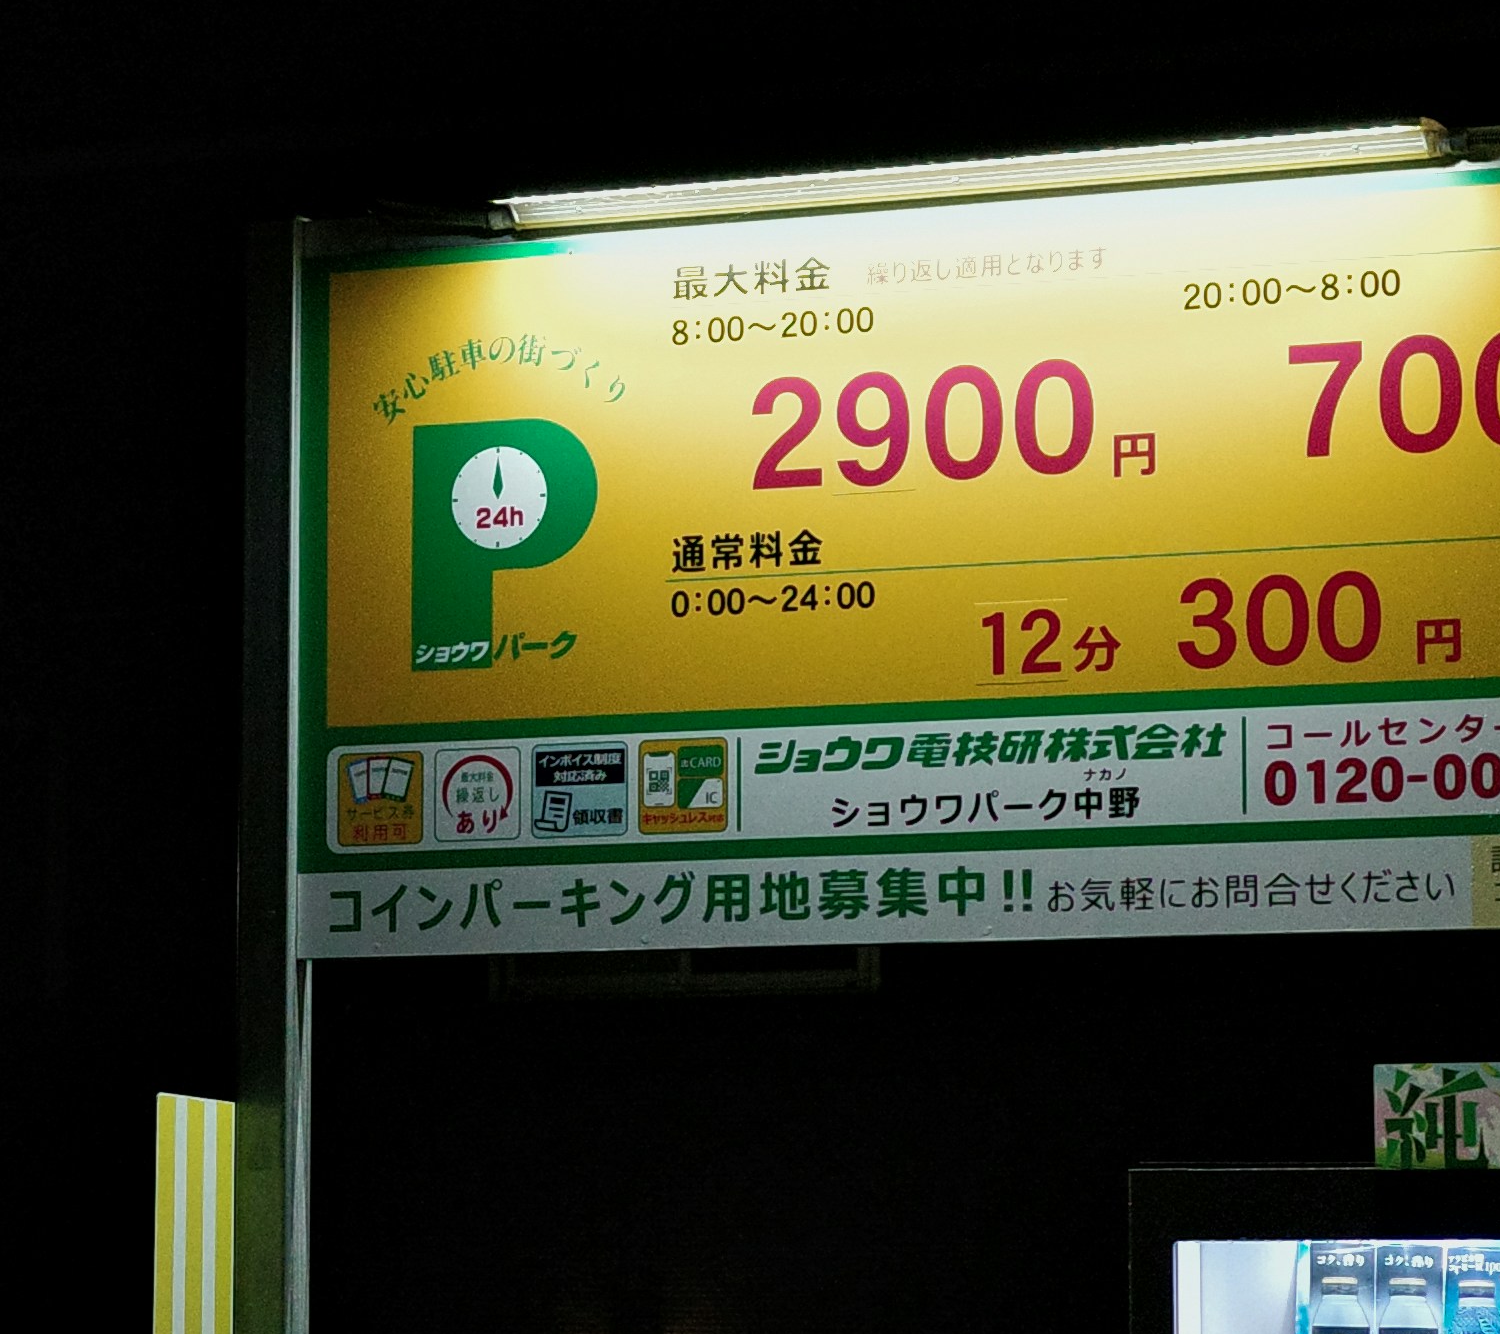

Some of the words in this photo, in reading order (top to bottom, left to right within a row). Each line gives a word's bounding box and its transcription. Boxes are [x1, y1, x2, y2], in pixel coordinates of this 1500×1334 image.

[672, 256, 832, 301] 最大料金
[866, 246, 1107, 287] 繰り返し適用となります
[371, 332, 627, 426] 安心駐車の街づくり
[475, 504, 525, 530] 24h
[671, 528, 824, 575] 通常料金
[754, 723, 1227, 774] ショウワ電技研株式会社
[538, 752, 622, 768] インボイス制度
[461, 771, 494, 783] 最大料金
[553, 769, 607, 783] 対応済み
[1083, 767, 1127, 782] ナカノ
[456, 787, 500, 803] 繰返し
[706, 791, 718, 805] IC
[347, 805, 415, 821] サービス券
[572, 807, 623, 825] 領収書
[831, 786, 1140, 828] ショウワパーク中野
[456, 809, 498, 834] あり
[352, 823, 407, 842] 利用可
[1048, 870, 1456, 914] お気軽にお問合せください
